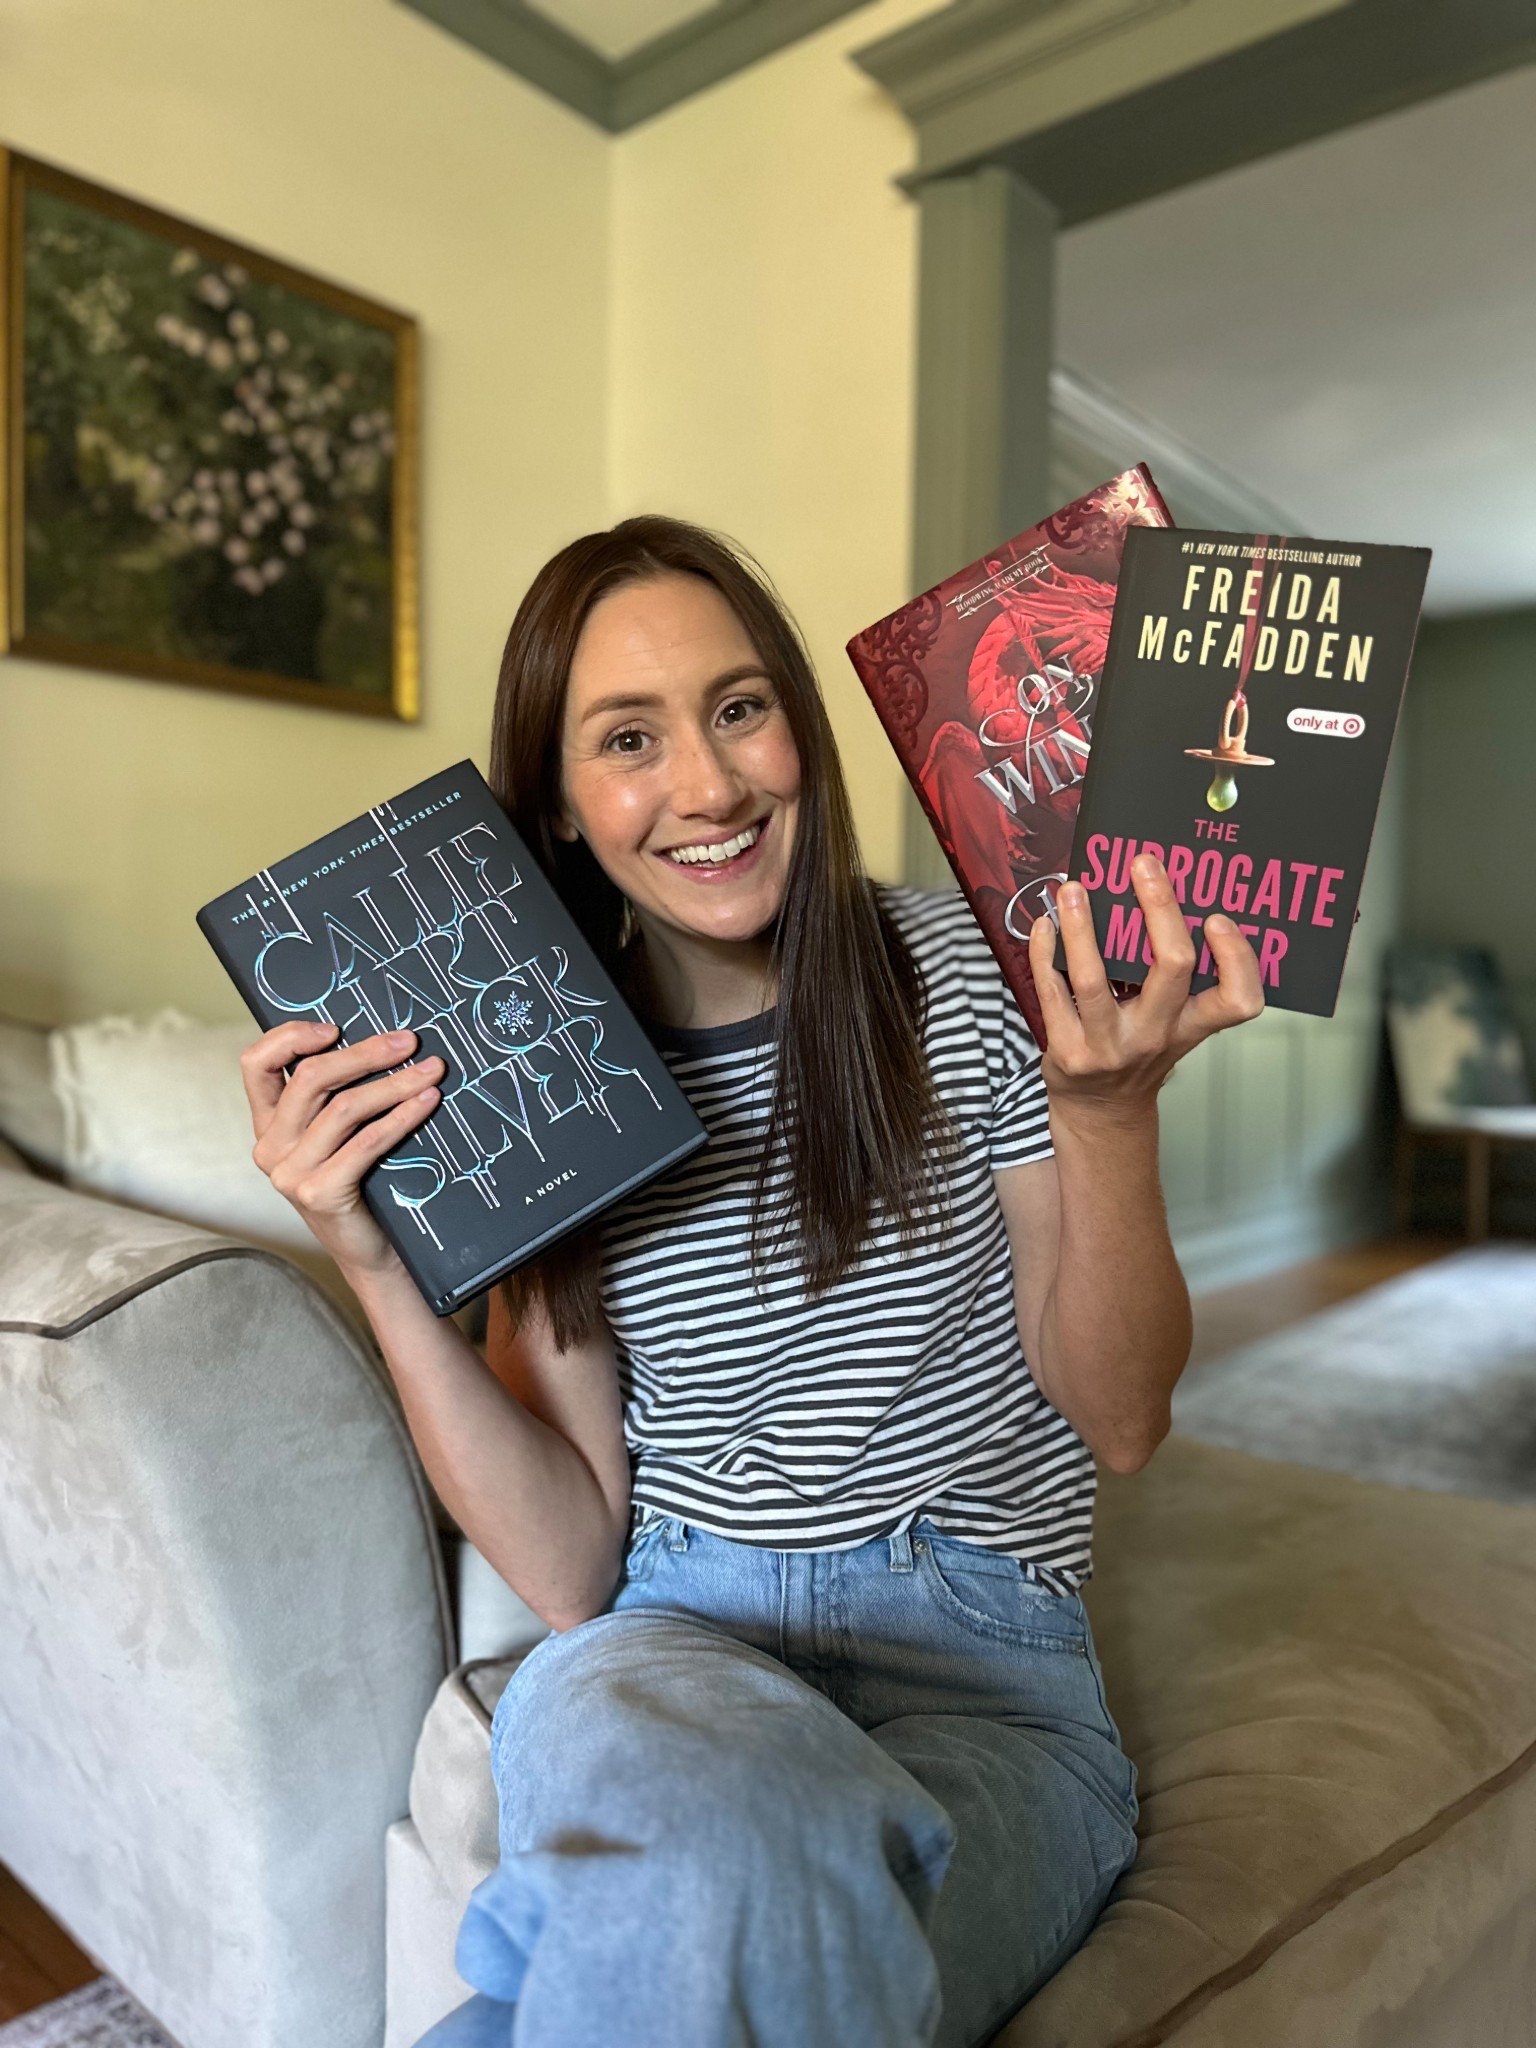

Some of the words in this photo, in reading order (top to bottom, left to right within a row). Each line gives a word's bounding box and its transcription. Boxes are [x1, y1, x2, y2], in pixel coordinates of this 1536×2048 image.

[1181, 541, 1194, 554] #1
[1196, 542, 1217, 556] NEW
[1216, 543, 1240, 557] YORK
[1240, 545, 1266, 560] TIMES
[1266, 548, 1324, 565] BESTSELLING
[1325, 552, 1363, 568] AUTHOR
[1182, 564, 1341, 625] FREIDA
[1137, 614, 1374, 683] McFADDEN
[1293, 715, 1323, 731] only
[1325, 719, 1339, 731] at
[1194, 818, 1240, 844] THE
[232, 907, 258, 925] THE
[262, 896, 277, 908] #1
[281, 877, 309, 897] NEW
[312, 856, 346, 879] YORK
[349, 834, 385, 859] TIMES
[388, 791, 462, 836] BESTSELLER
[254, 821, 524, 1013] CALLIE
[525, 1195, 534, 1206] A
[536, 1168, 578, 1197] NOVEL
